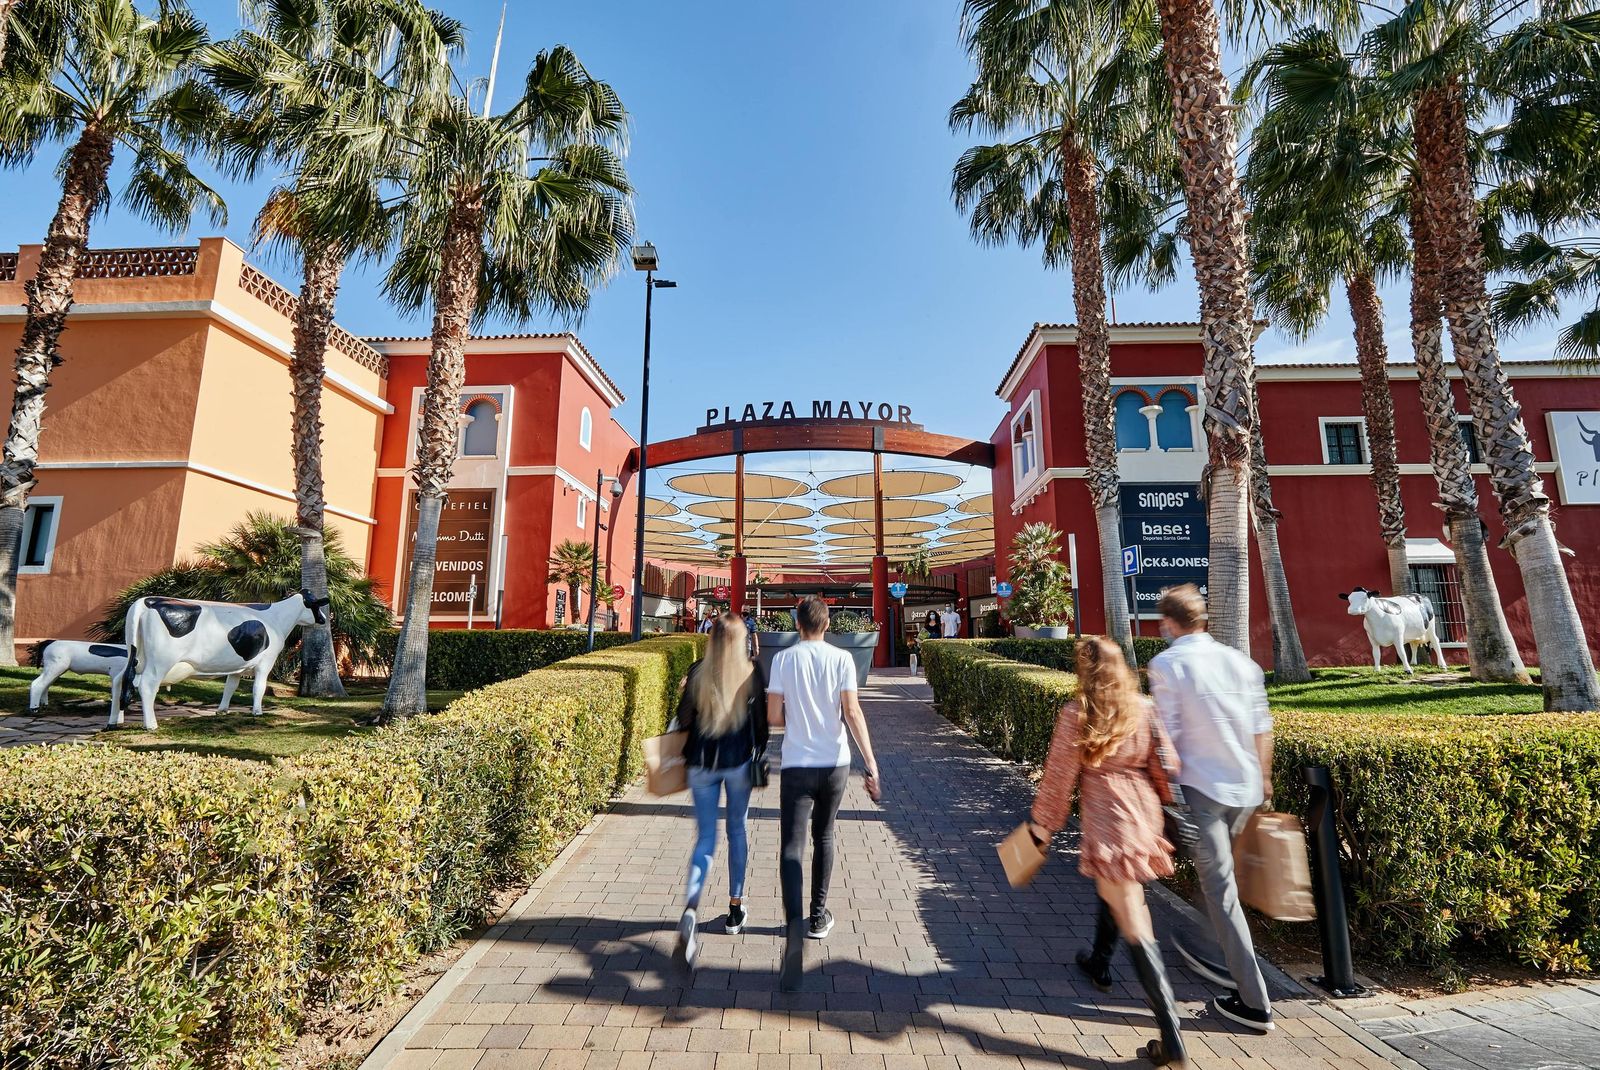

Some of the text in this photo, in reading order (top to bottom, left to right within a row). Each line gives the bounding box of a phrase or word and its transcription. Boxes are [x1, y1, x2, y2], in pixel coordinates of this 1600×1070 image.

[706, 400, 912, 426] PLAZA MAYOR
[415, 502, 488, 510] CTEFIEL
[1138, 492, 1184, 511] snipes
[459, 530, 485, 542] Dutti
[410, 561, 483, 571] VENIDOS
[1124, 550, 1134, 573] P
[1141, 558, 1208, 567] CK&JONES
[430, 591, 472, 603] ELCOME
